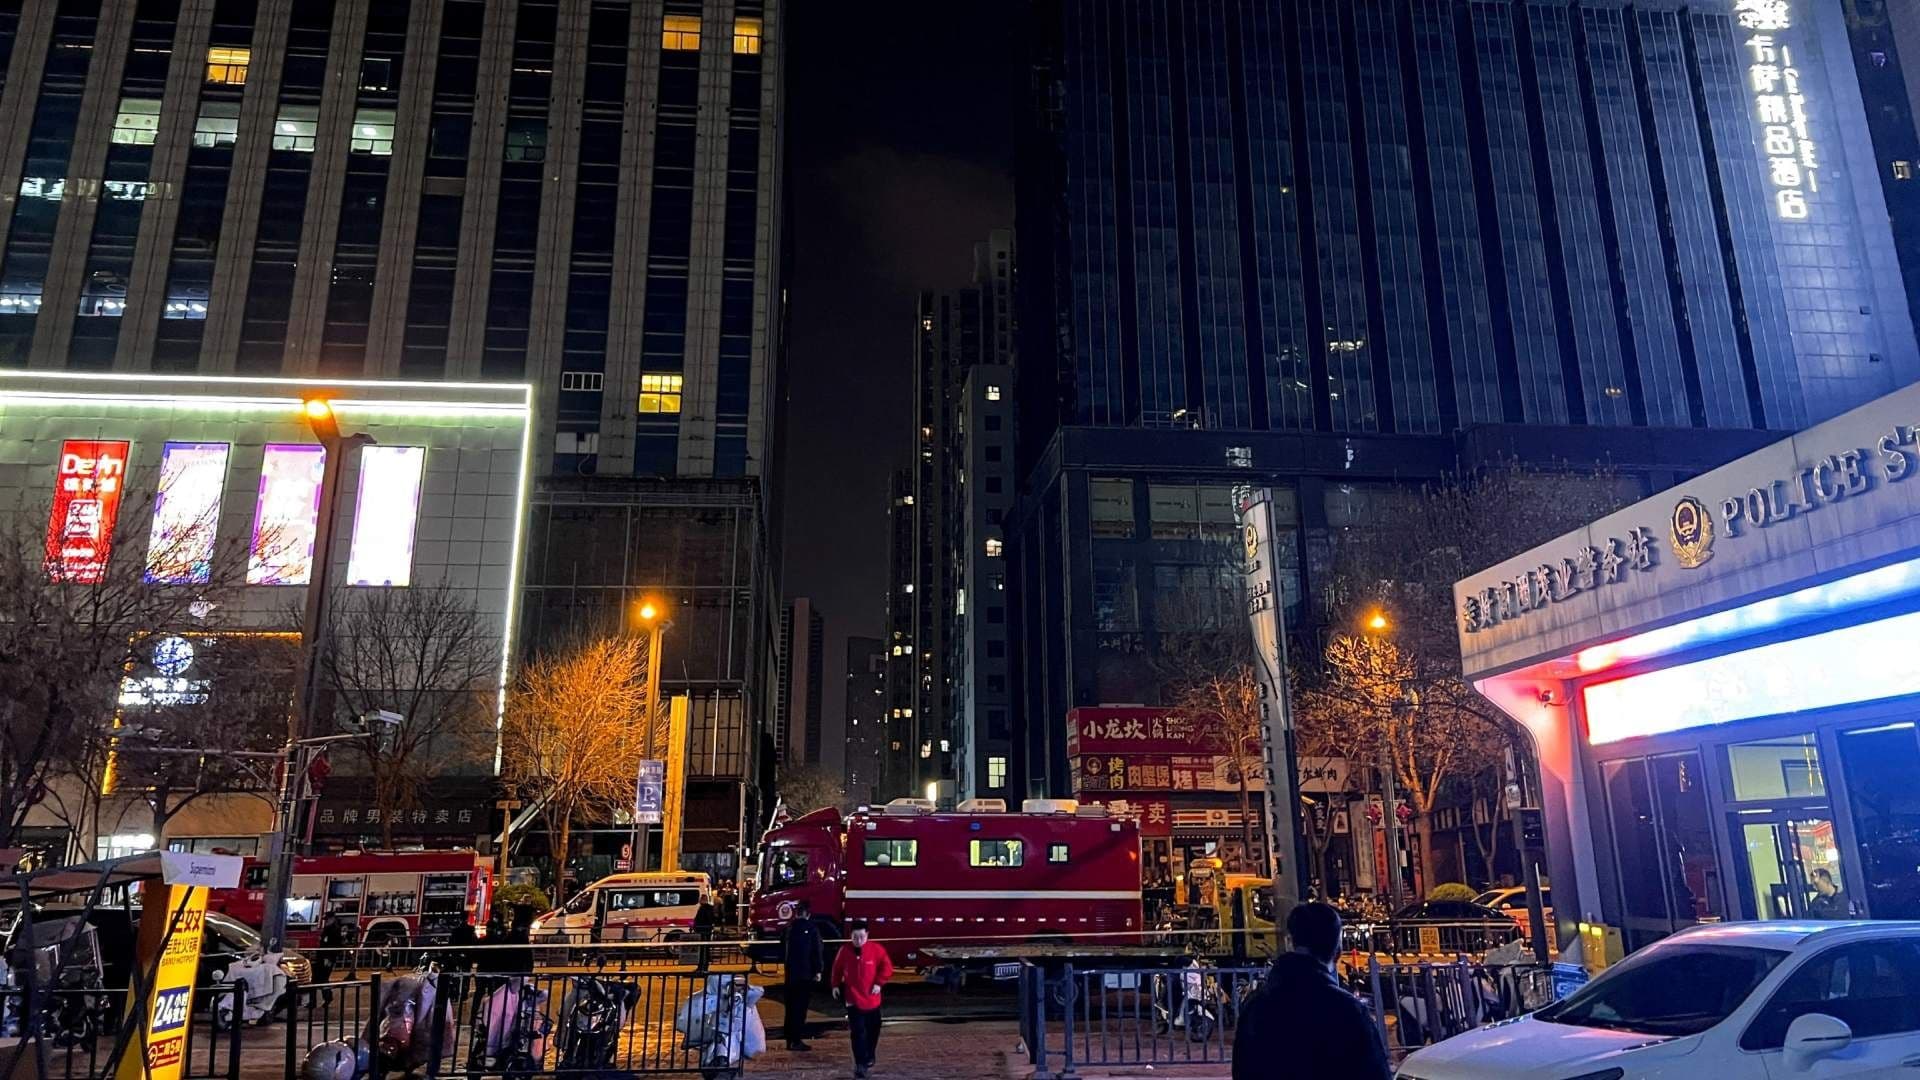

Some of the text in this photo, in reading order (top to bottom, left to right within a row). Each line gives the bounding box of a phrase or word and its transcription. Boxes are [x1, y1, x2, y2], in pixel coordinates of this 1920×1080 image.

[1720, 448, 1868, 538] POLICE
[1082, 718, 1147, 740] 小龙坎
[643, 786, 655, 802] P
[320, 808, 473, 825] 品牌男装特卖店
[153, 993, 174, 1027] 24
